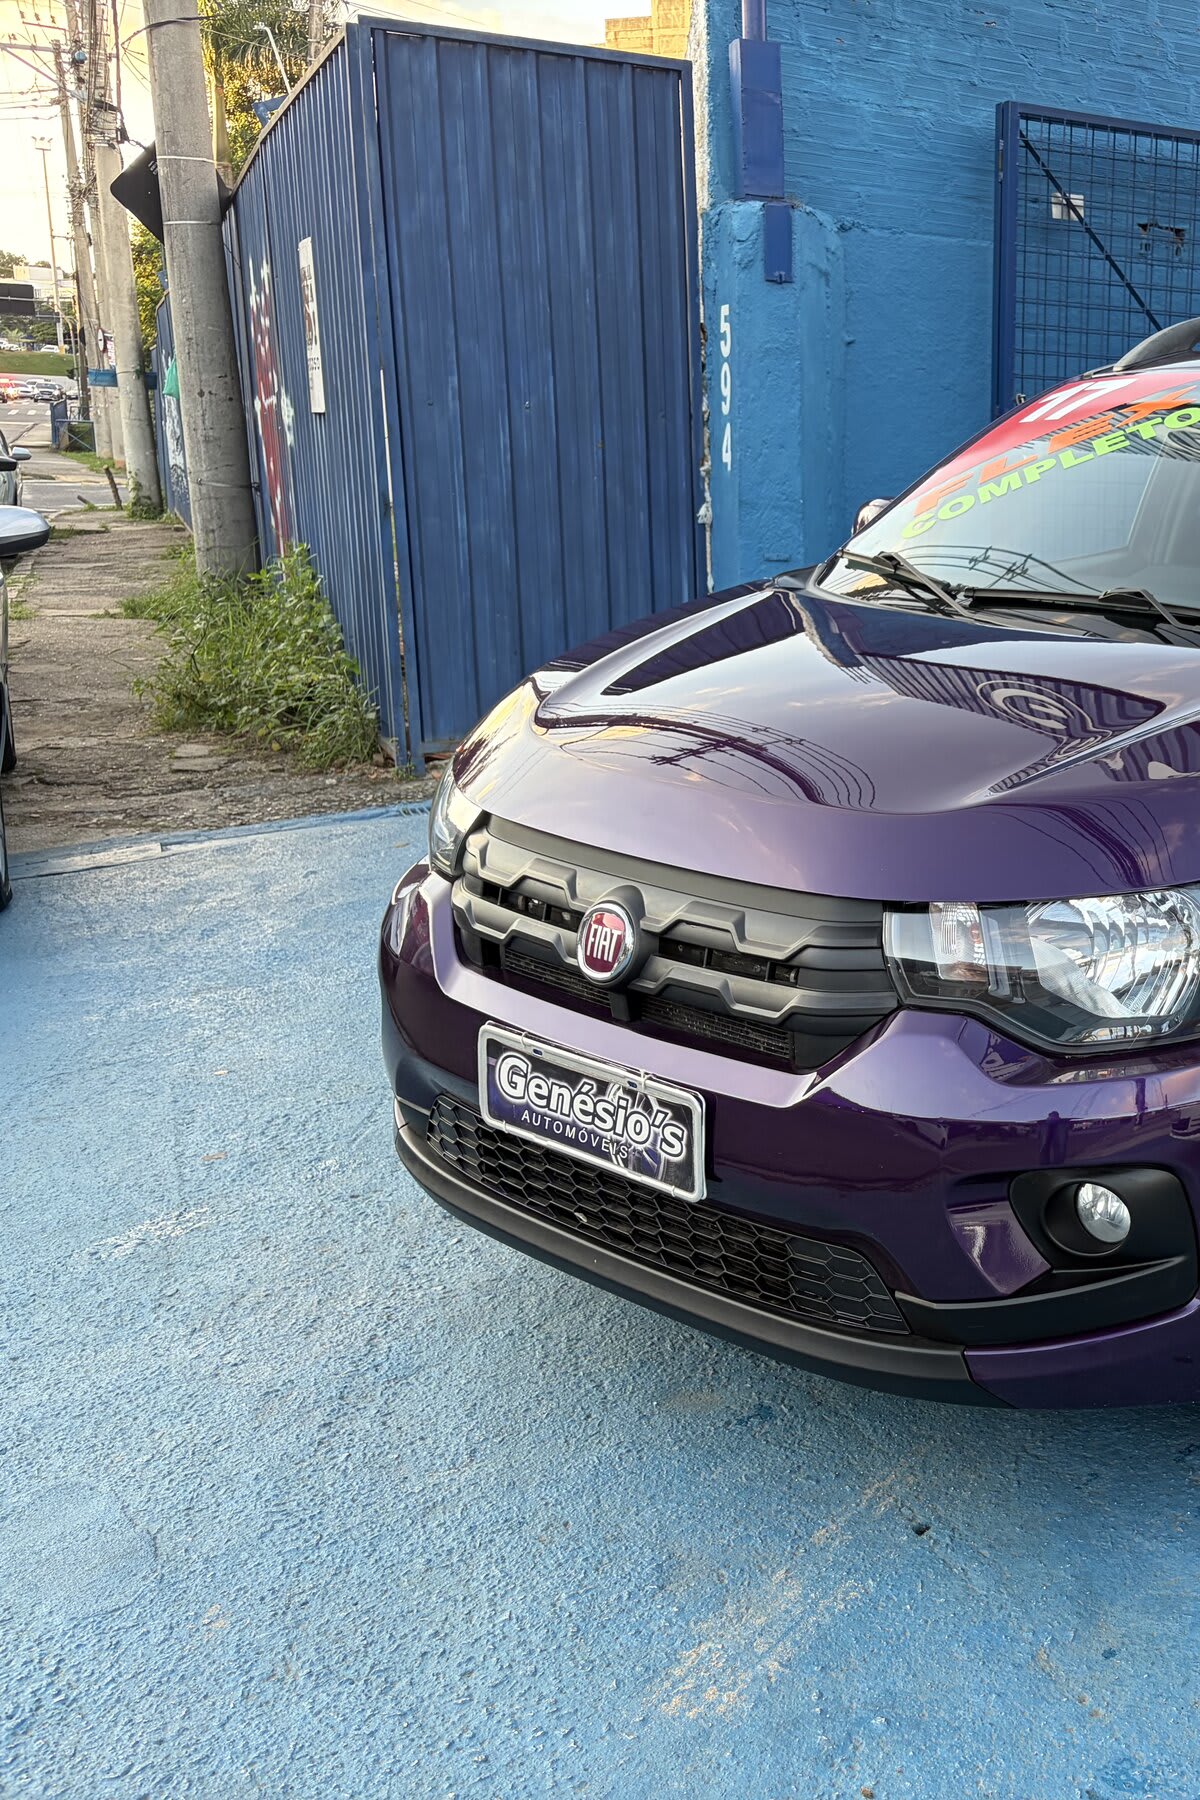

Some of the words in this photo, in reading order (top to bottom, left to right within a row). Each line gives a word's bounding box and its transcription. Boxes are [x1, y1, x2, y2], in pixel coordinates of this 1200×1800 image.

[720, 304, 732, 472] 594
[1019, 378, 1138, 422] 17
[913, 385, 1198, 516] FLEX
[586, 924, 622, 963] FIAT
[497, 1053, 687, 1158] Genésio's
[521, 1109, 629, 1159] AUTOMÓVEIS
